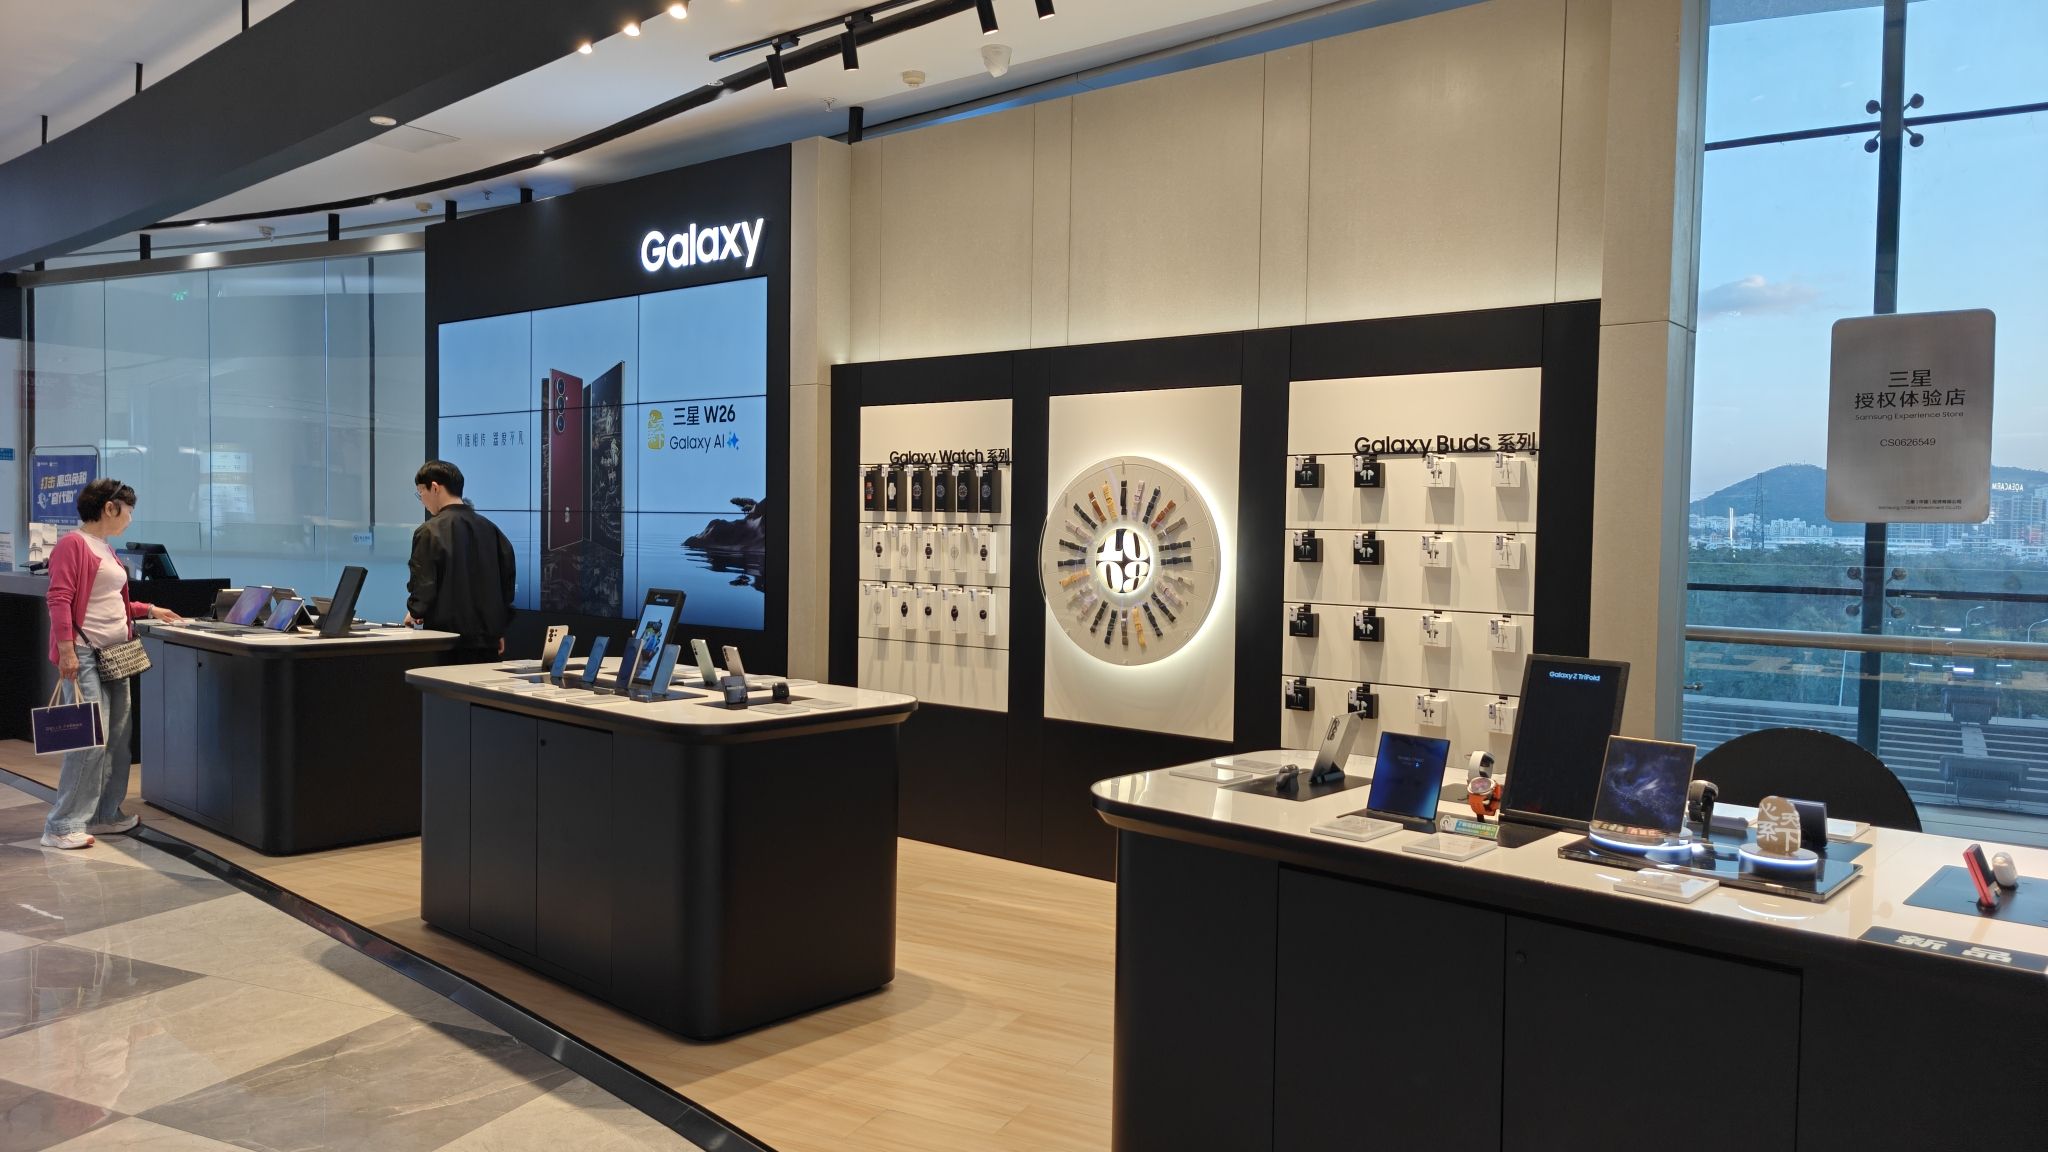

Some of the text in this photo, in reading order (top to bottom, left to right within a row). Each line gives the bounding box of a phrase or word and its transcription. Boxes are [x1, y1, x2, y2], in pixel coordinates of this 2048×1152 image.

[641, 218, 764, 272] Galaxy
[1887, 368, 1932, 388] 三星
[1854, 388, 1966, 410] 授权体验店
[673, 404, 736, 426] 三星 W26
[1855, 413, 1892, 422] Samsung
[1894, 412, 1941, 421] Experience
[670, 433, 725, 454] Galaxy AI
[1354, 432, 1536, 457] Galaxy Buds 系列
[1880, 438, 1936, 447] CS0626549
[889, 448, 1010, 464] Galaxy Watch 系列
[1549, 671, 1572, 680] Galaxy
[1578, 673, 1601, 682] TriFold
